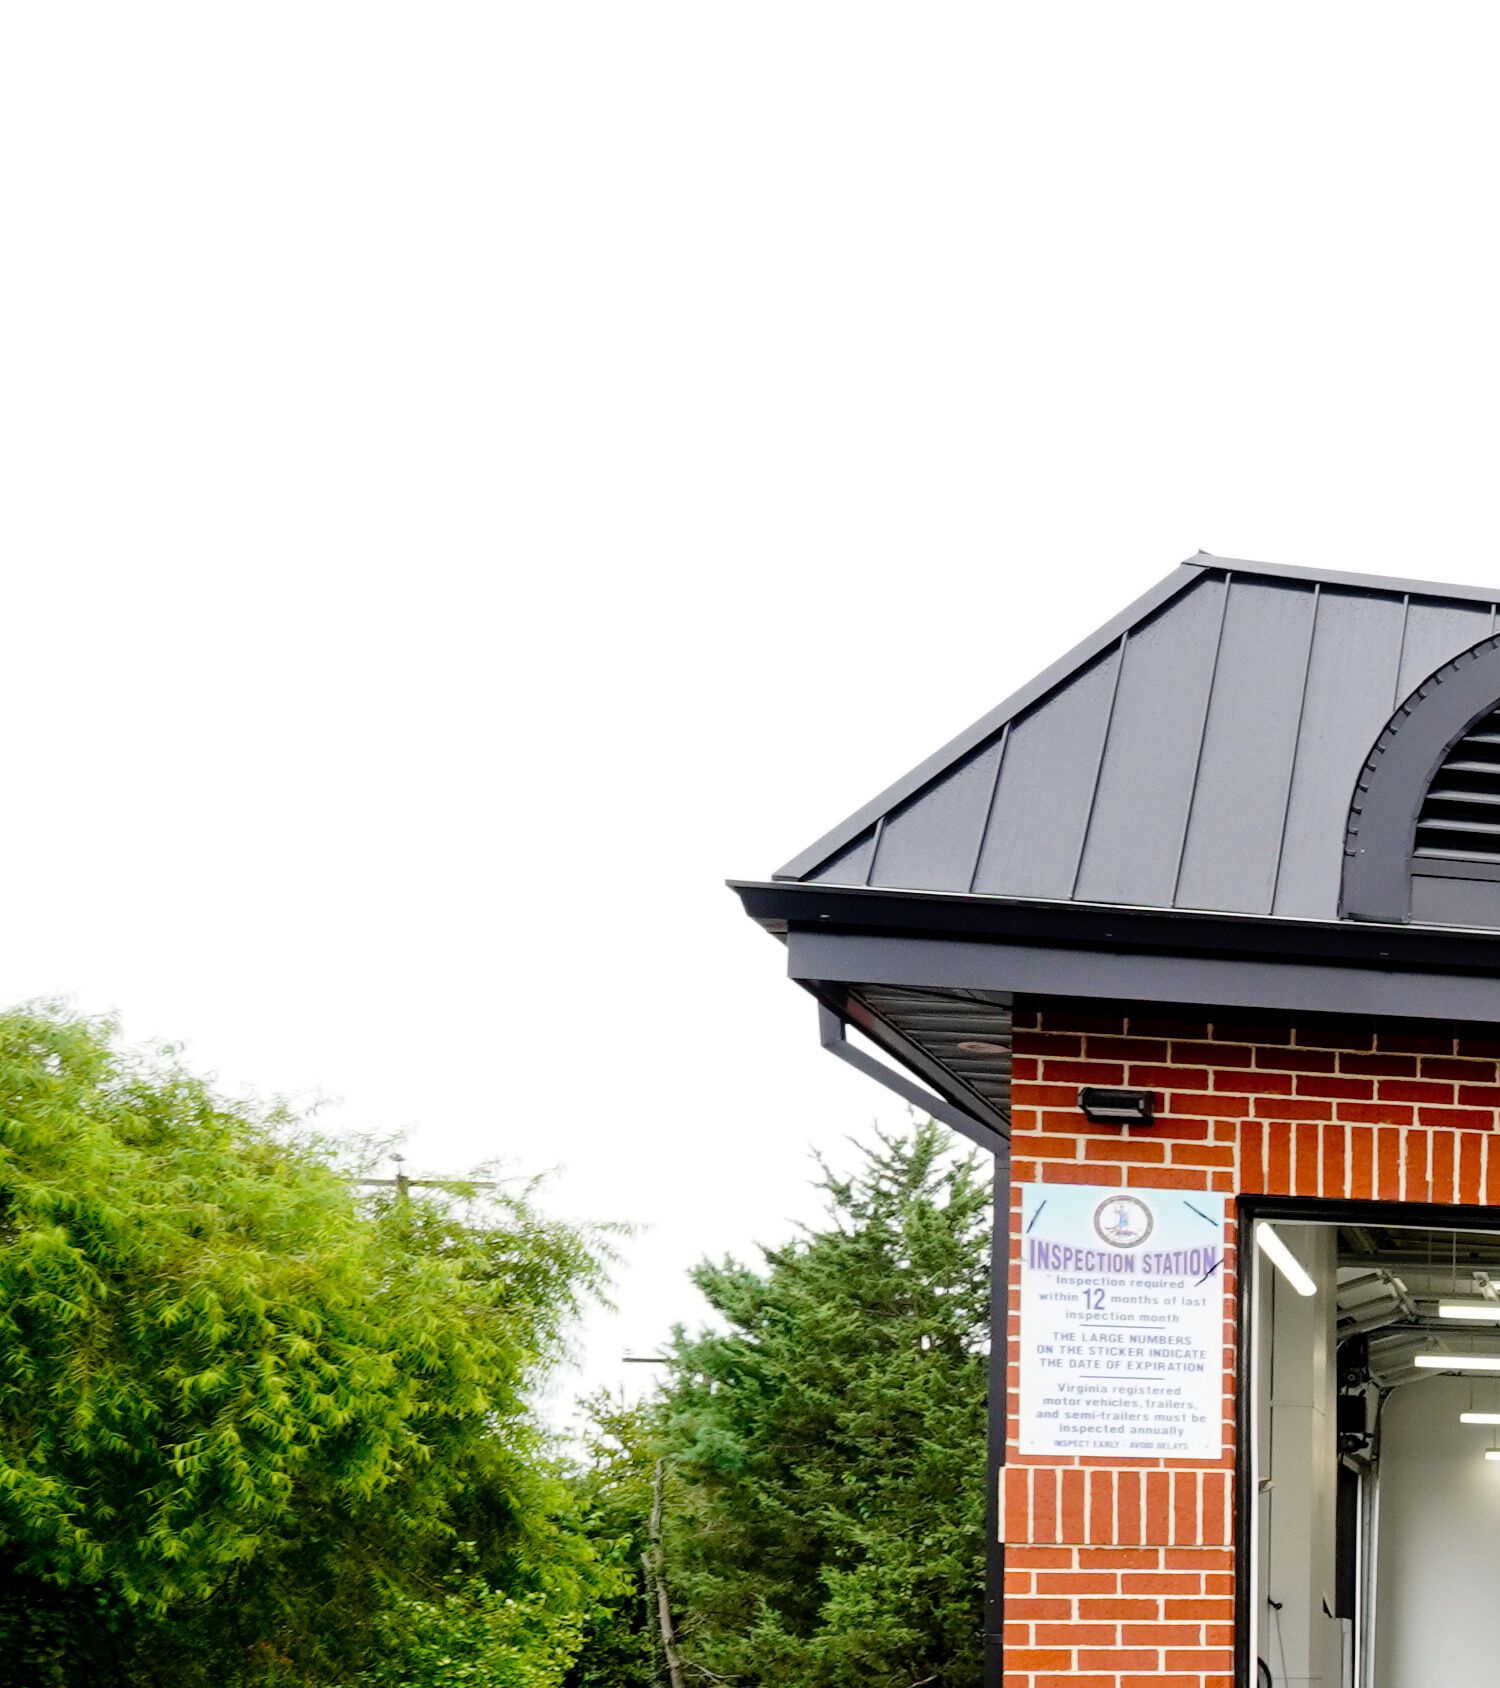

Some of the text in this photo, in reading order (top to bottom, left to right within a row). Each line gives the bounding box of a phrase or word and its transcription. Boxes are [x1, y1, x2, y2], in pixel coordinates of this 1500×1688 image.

[1029, 1239, 1216, 1277] INSPECTION STATION
[1056, 1275, 1184, 1290] Inspection required
[1038, 1288, 1206, 1310] within 12 months of last
[1065, 1309, 1179, 1323] inspection month
[1052, 1331, 1192, 1346] THE LARGE NUMBERS
[1036, 1344, 1207, 1360] ON THE STICKER INDICATE
[1039, 1358, 1205, 1372] THE DATE OF EXPIRATION
[1057, 1383, 1182, 1396] Virginia registered
[1042, 1396, 1198, 1410] motor vehicles, trailers,
[1036, 1410, 1207, 1423] and semi-trailers must be
[1059, 1423, 1184, 1437] inspected annually
[1054, 1439, 1089, 1448] INSPECT
